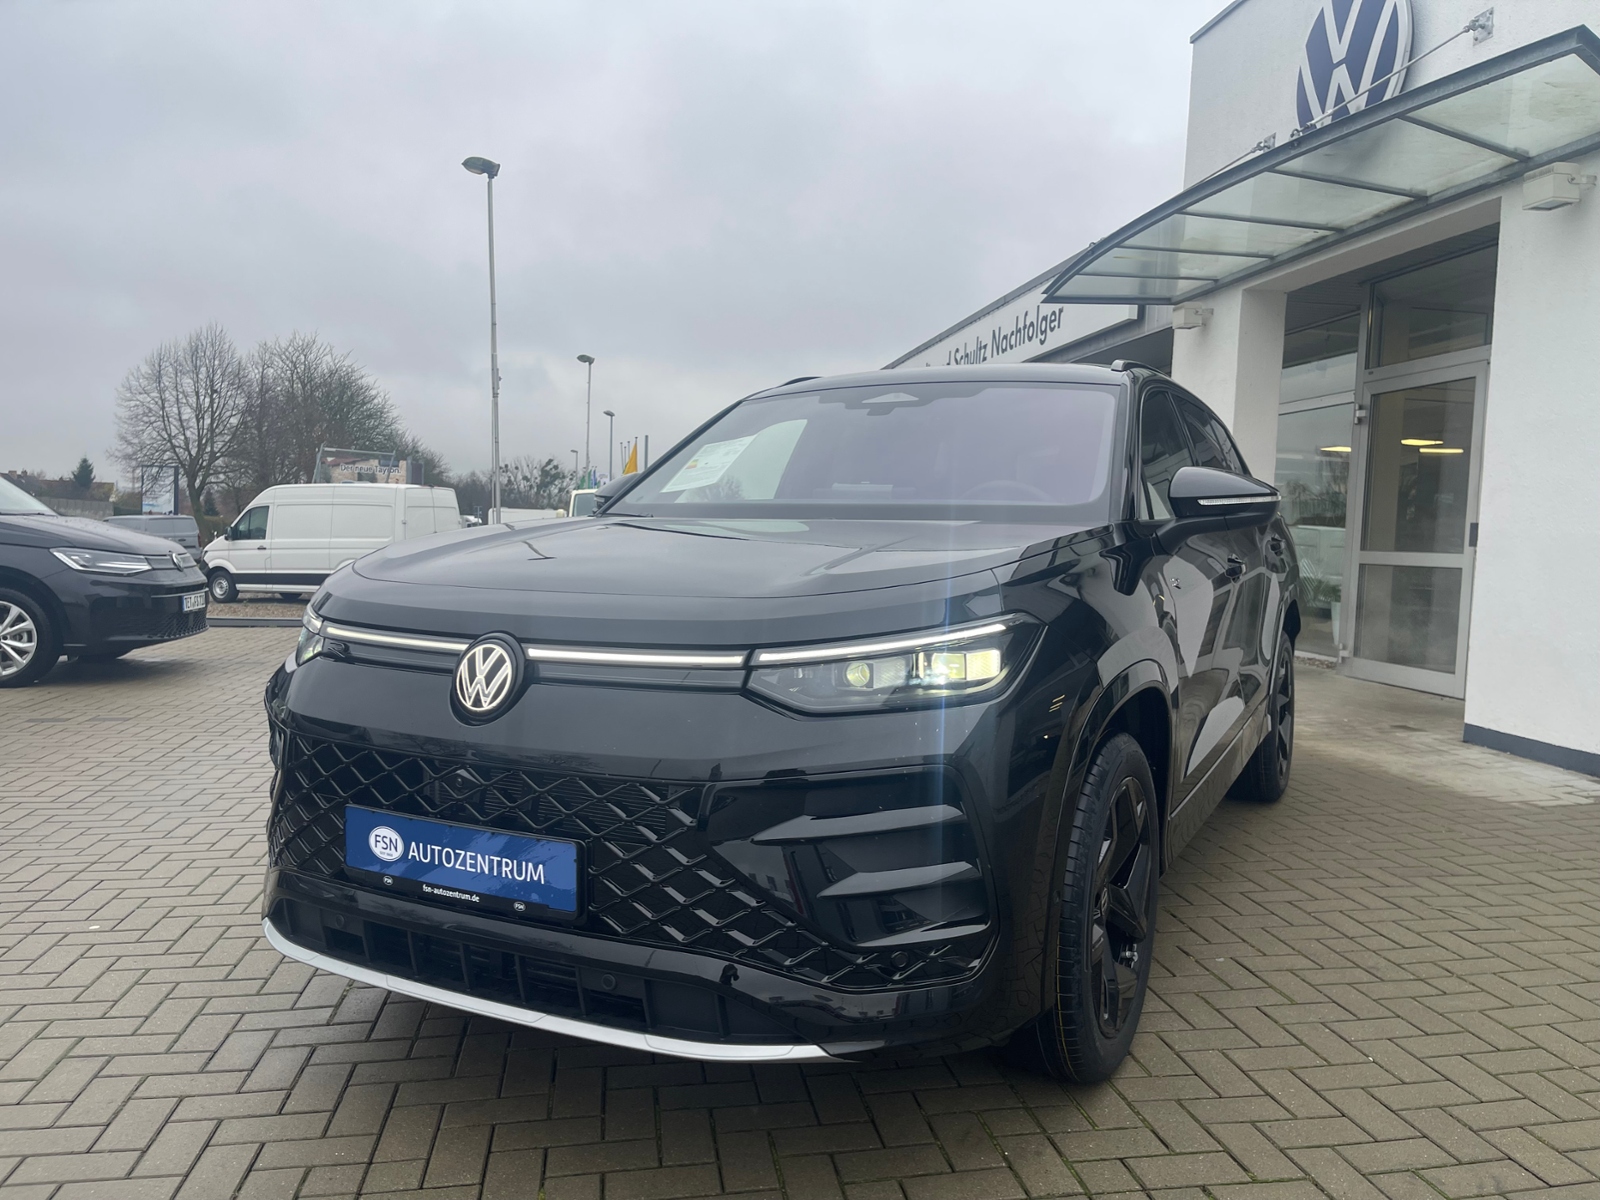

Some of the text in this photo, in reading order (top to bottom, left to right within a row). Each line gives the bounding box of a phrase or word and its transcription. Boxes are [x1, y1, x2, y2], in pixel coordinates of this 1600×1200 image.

[991, 305, 1064, 358] Nachfolger
[340, 464, 353, 472] Der
[354, 465, 373, 473] neue
[459, 645, 511, 709] VW
[374, 834, 545, 885] FSN AUTOZENTRUM
[422, 884, 480, 903] fsn-autozentrum.de
